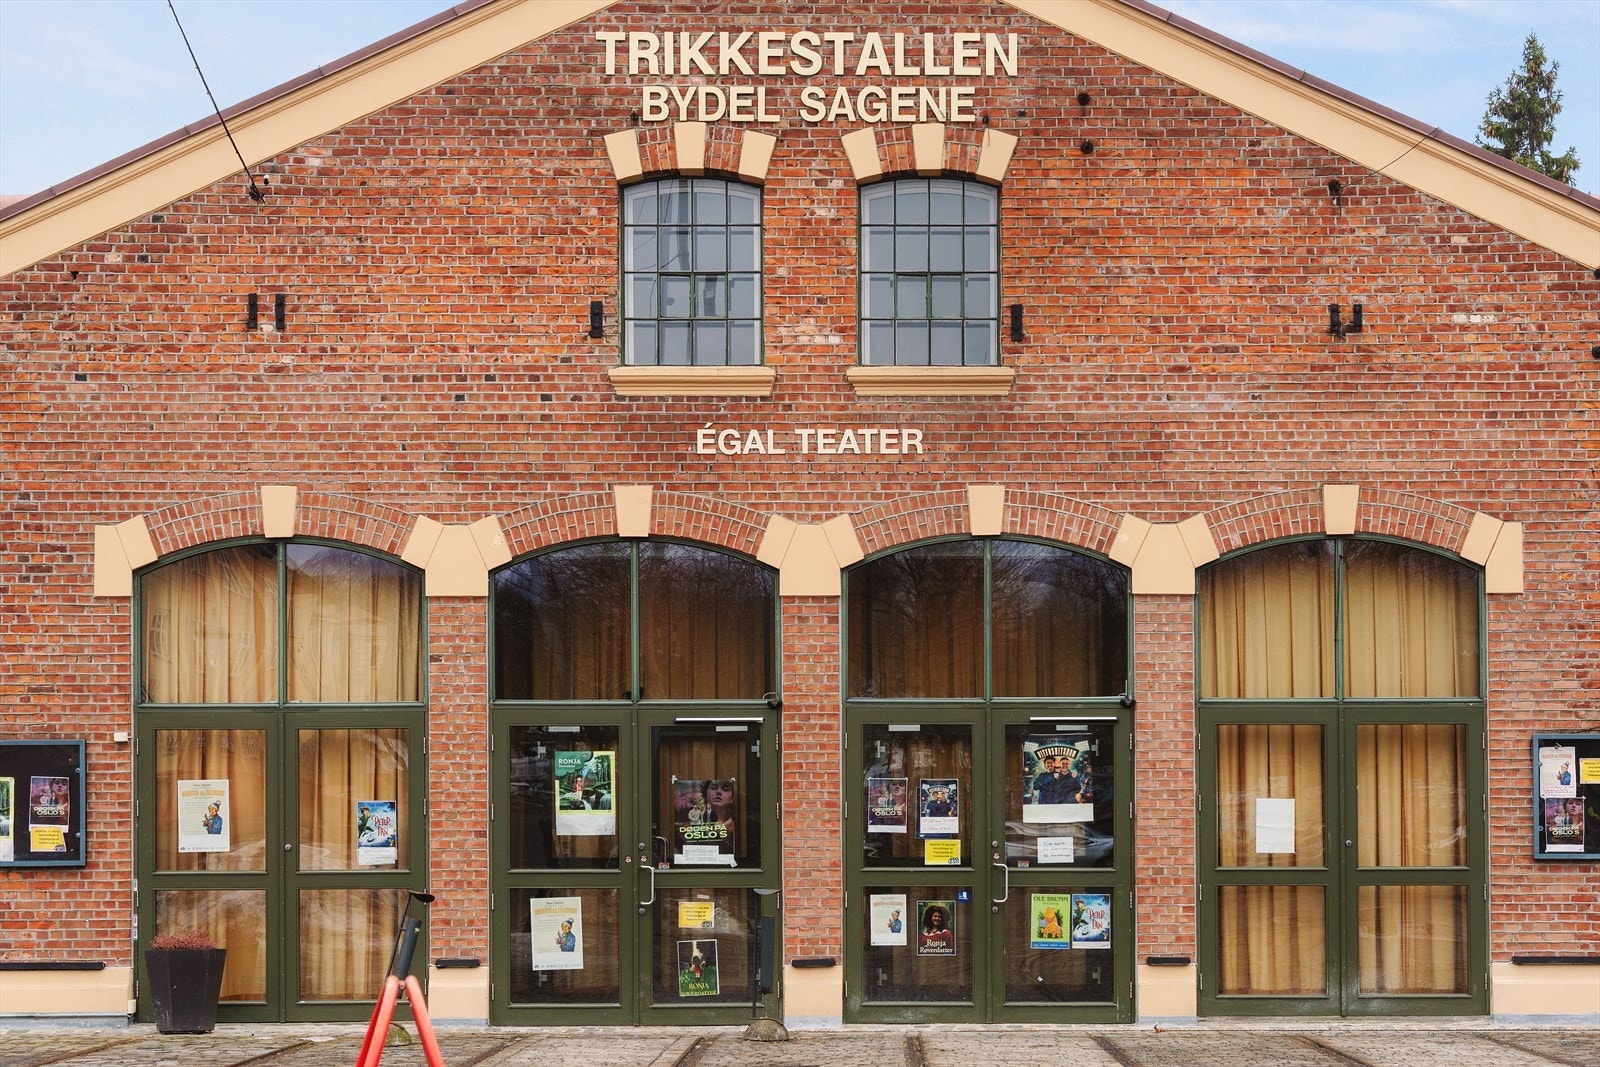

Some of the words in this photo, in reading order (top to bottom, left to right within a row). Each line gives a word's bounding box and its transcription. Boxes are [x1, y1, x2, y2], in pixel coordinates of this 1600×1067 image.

[595, 31, 1019, 76] TRIKKESTALLEN
[642, 86, 781, 122] BYDEL
[799, 86, 977, 123] SAGENE
[696, 422, 786, 455] ÉGAL
[794, 428, 924, 455] TEATER
[373, 815, 392, 827] PETER
[377, 826, 389, 837] PAN
[679, 825, 714, 833] DØDEN
[684, 831, 718, 839] OSLO
[719, 830, 728, 838] S
[1089, 908, 1106, 919] PETER
[1091, 919, 1103, 930] PAN
[925, 938, 947, 948] Ronja
[688, 982, 709, 990] RONJA
